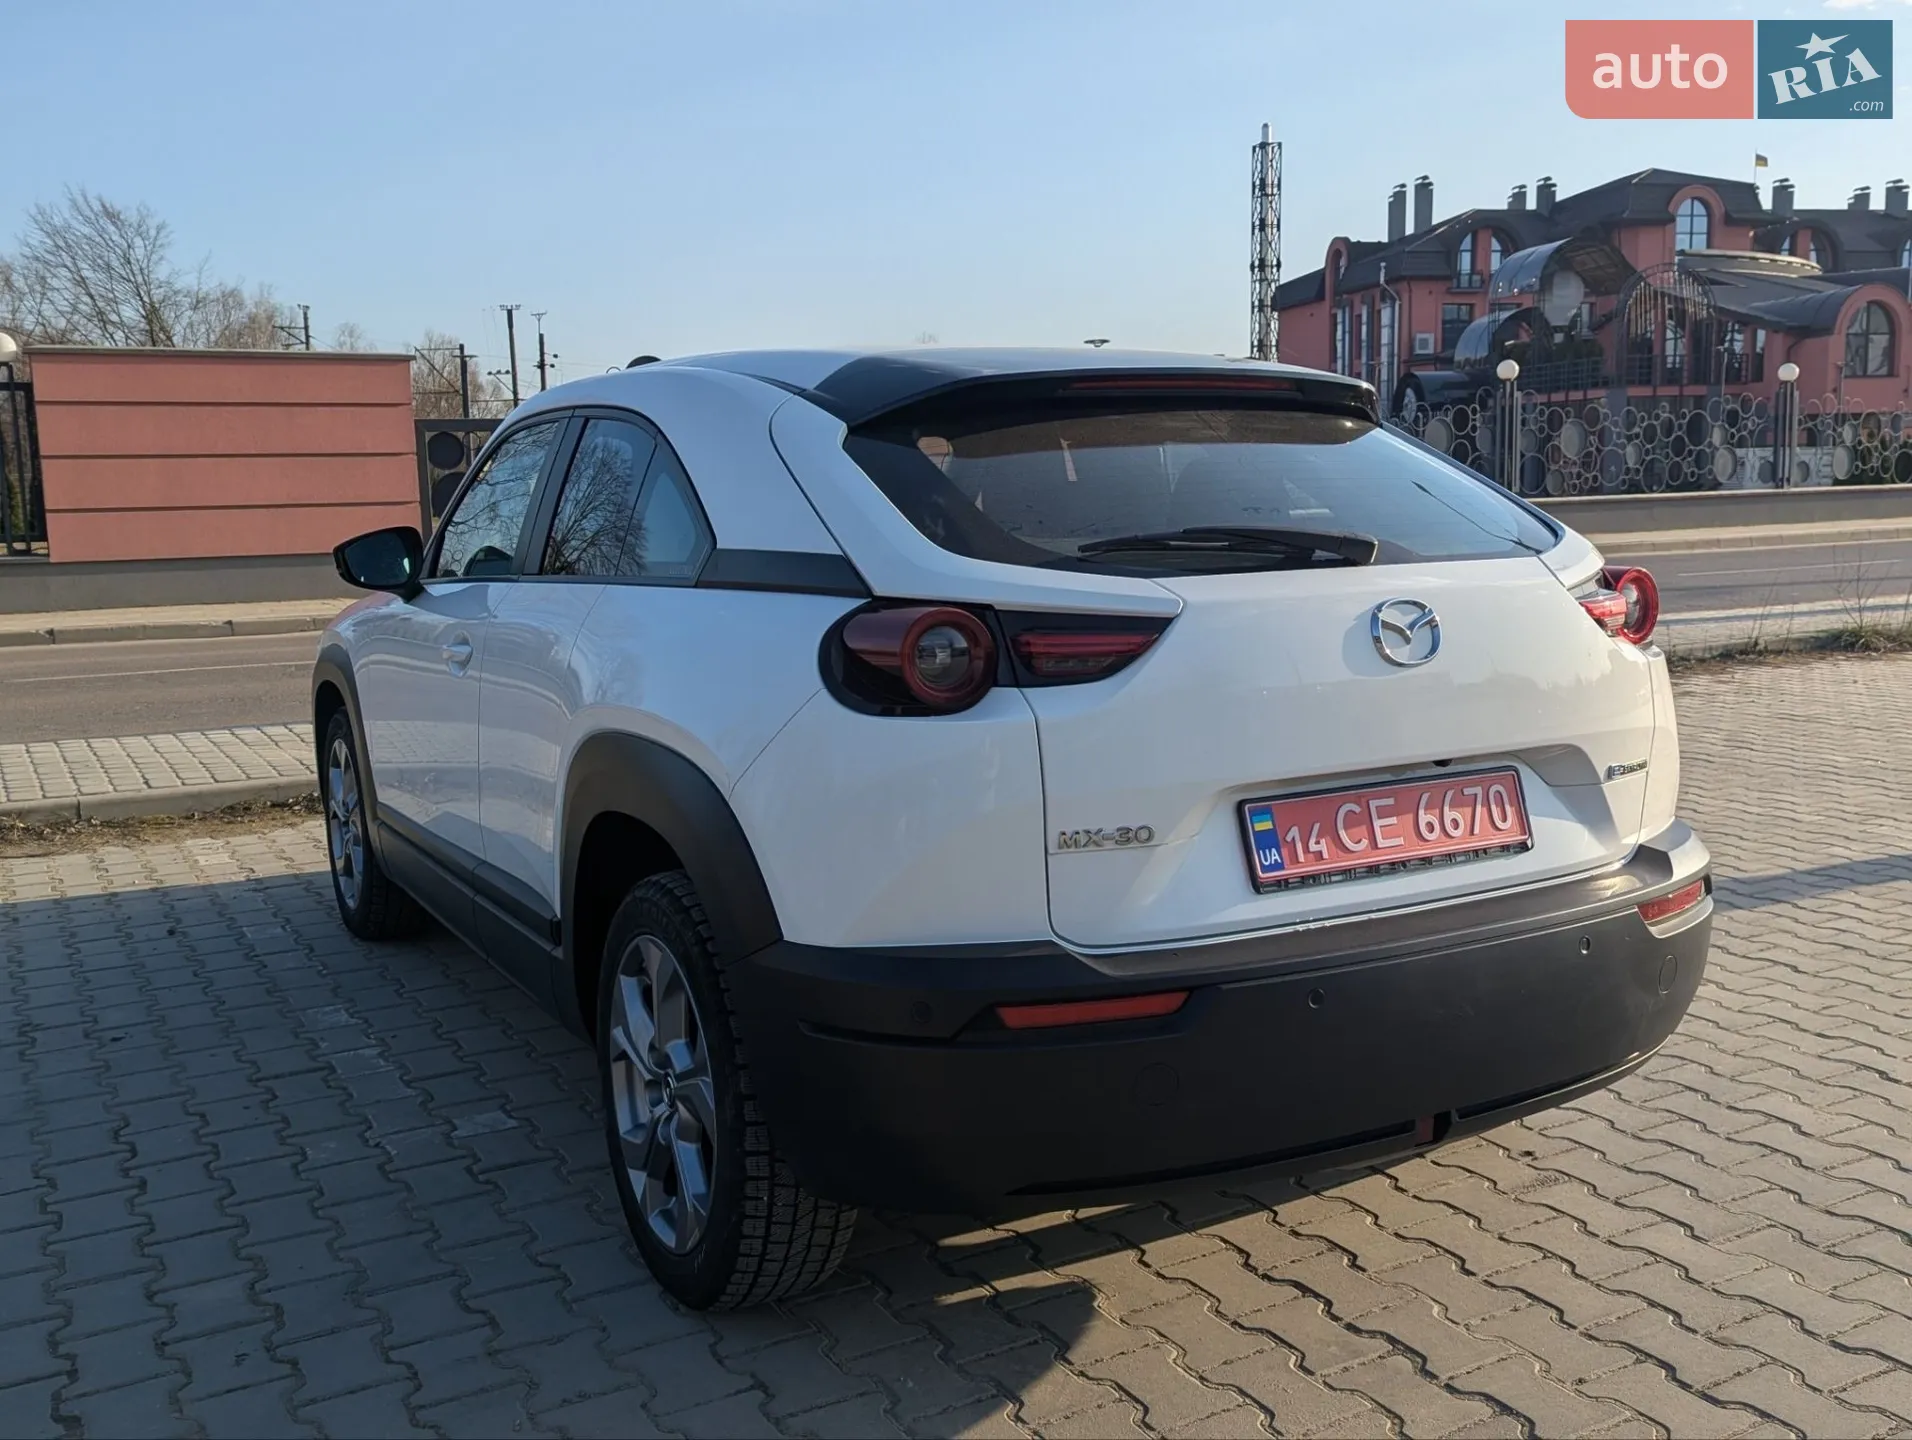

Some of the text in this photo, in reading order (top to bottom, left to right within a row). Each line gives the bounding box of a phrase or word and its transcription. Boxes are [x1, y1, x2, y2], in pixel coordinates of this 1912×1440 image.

[1058, 825, 1155, 849] MX-30
[1260, 784, 1513, 866] UA 14 CE 6670
